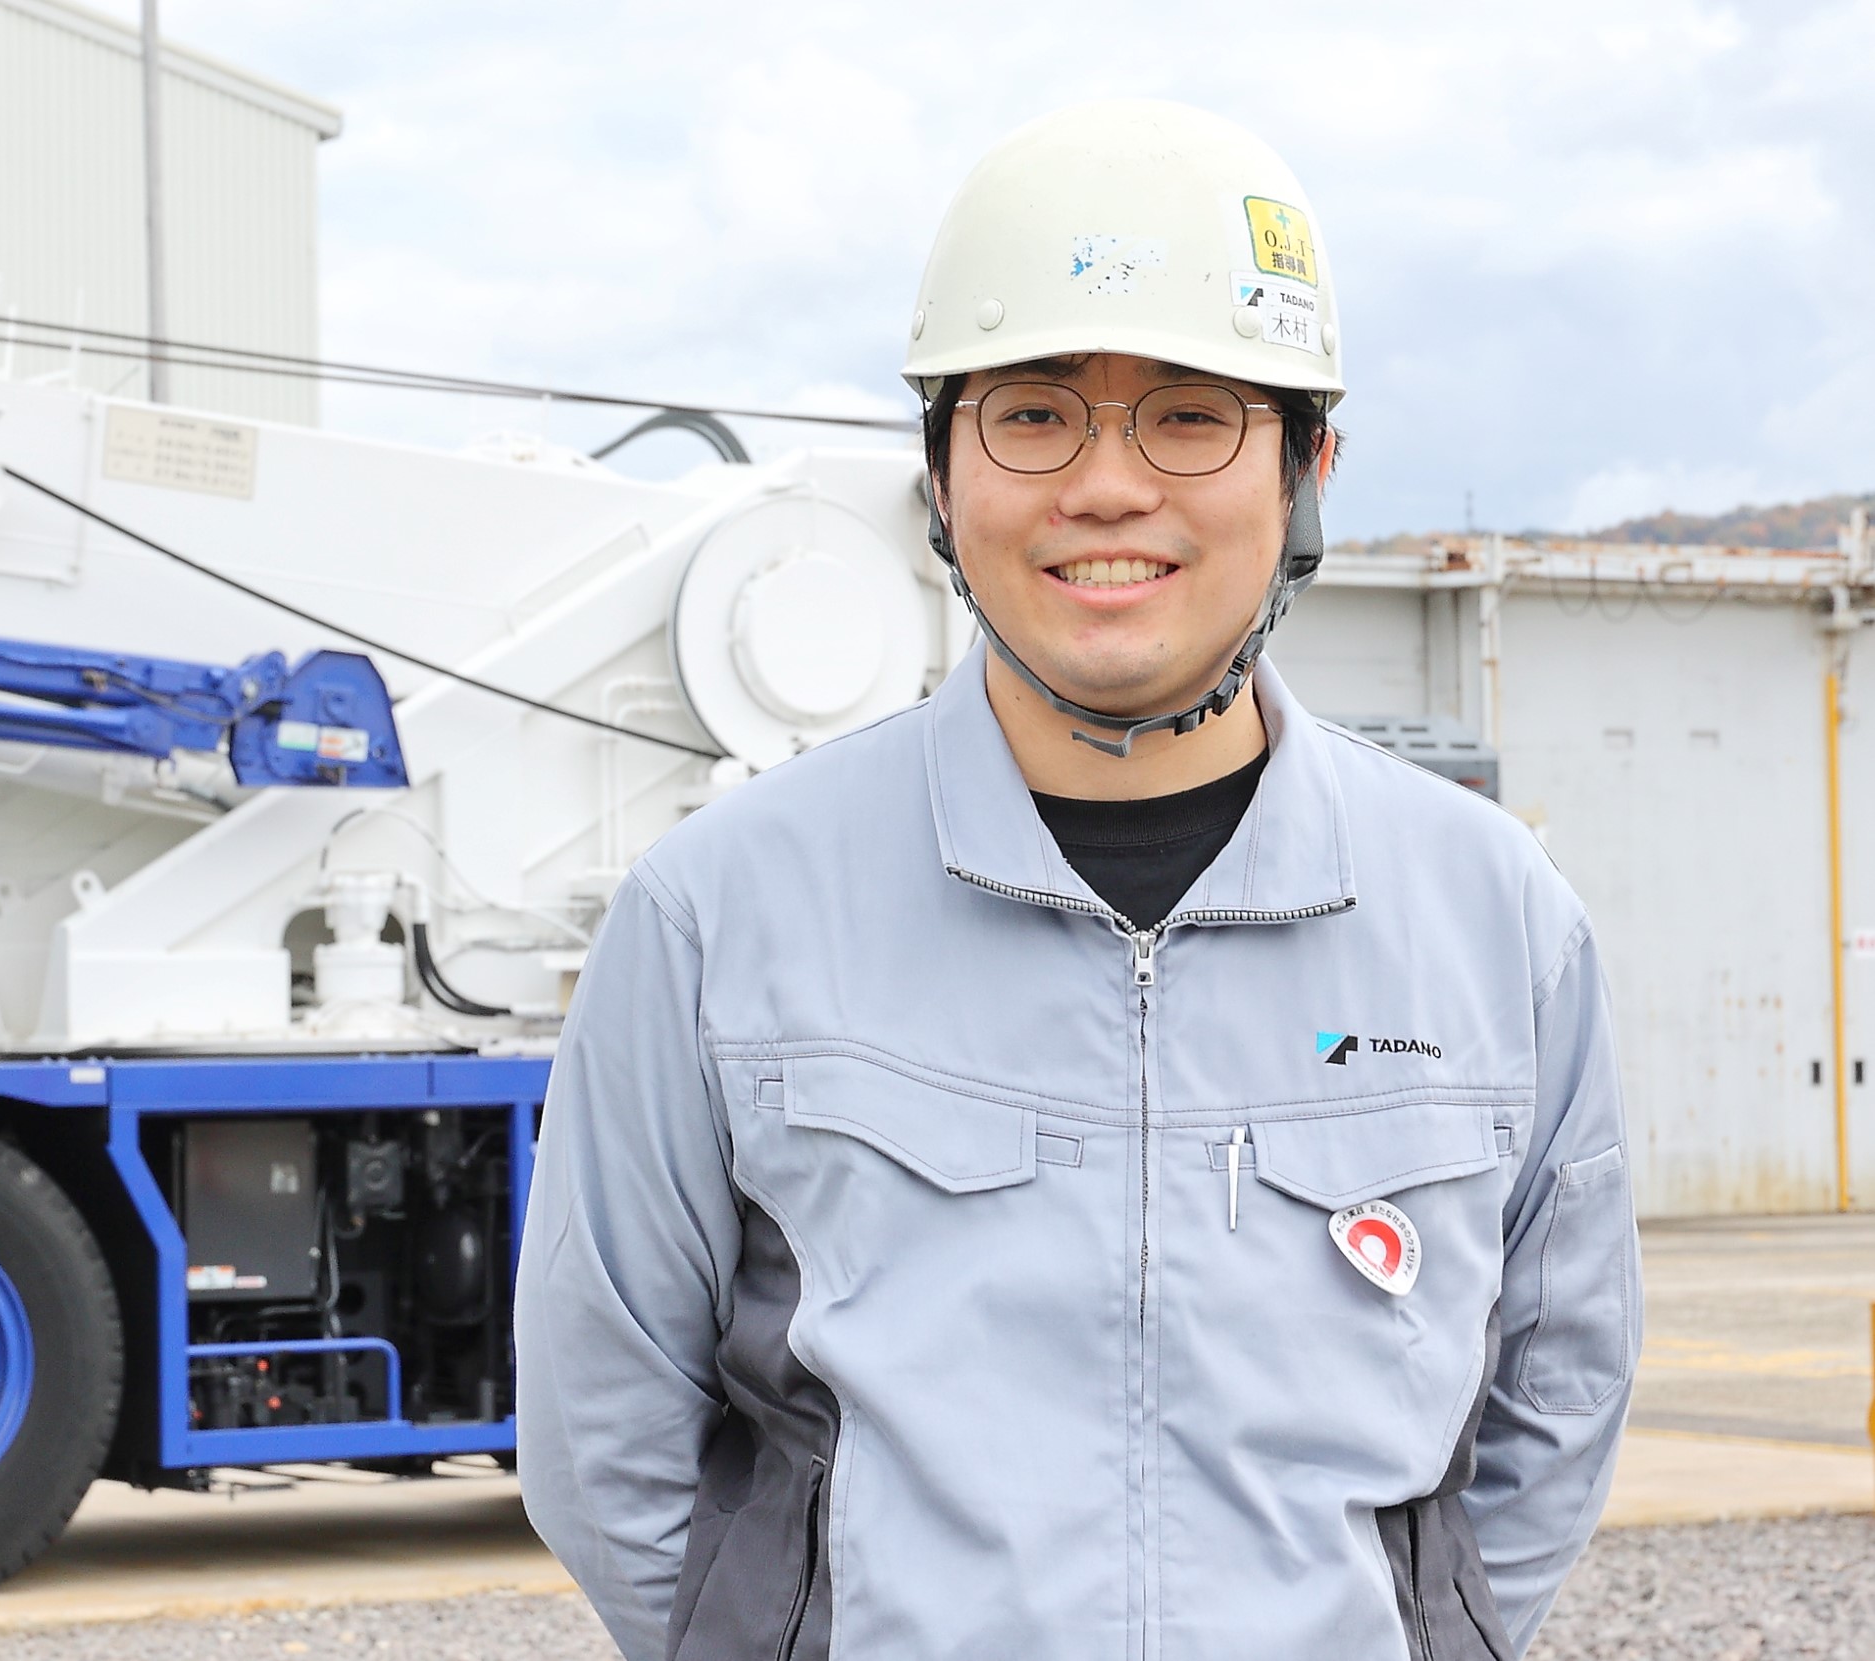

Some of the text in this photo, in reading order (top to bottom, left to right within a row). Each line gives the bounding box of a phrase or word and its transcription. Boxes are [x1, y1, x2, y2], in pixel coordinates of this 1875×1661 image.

[1279, 292, 1315, 312] TADANO
[1271, 311, 1308, 344] 木村
[1369, 1037, 1443, 1060] TADANO
